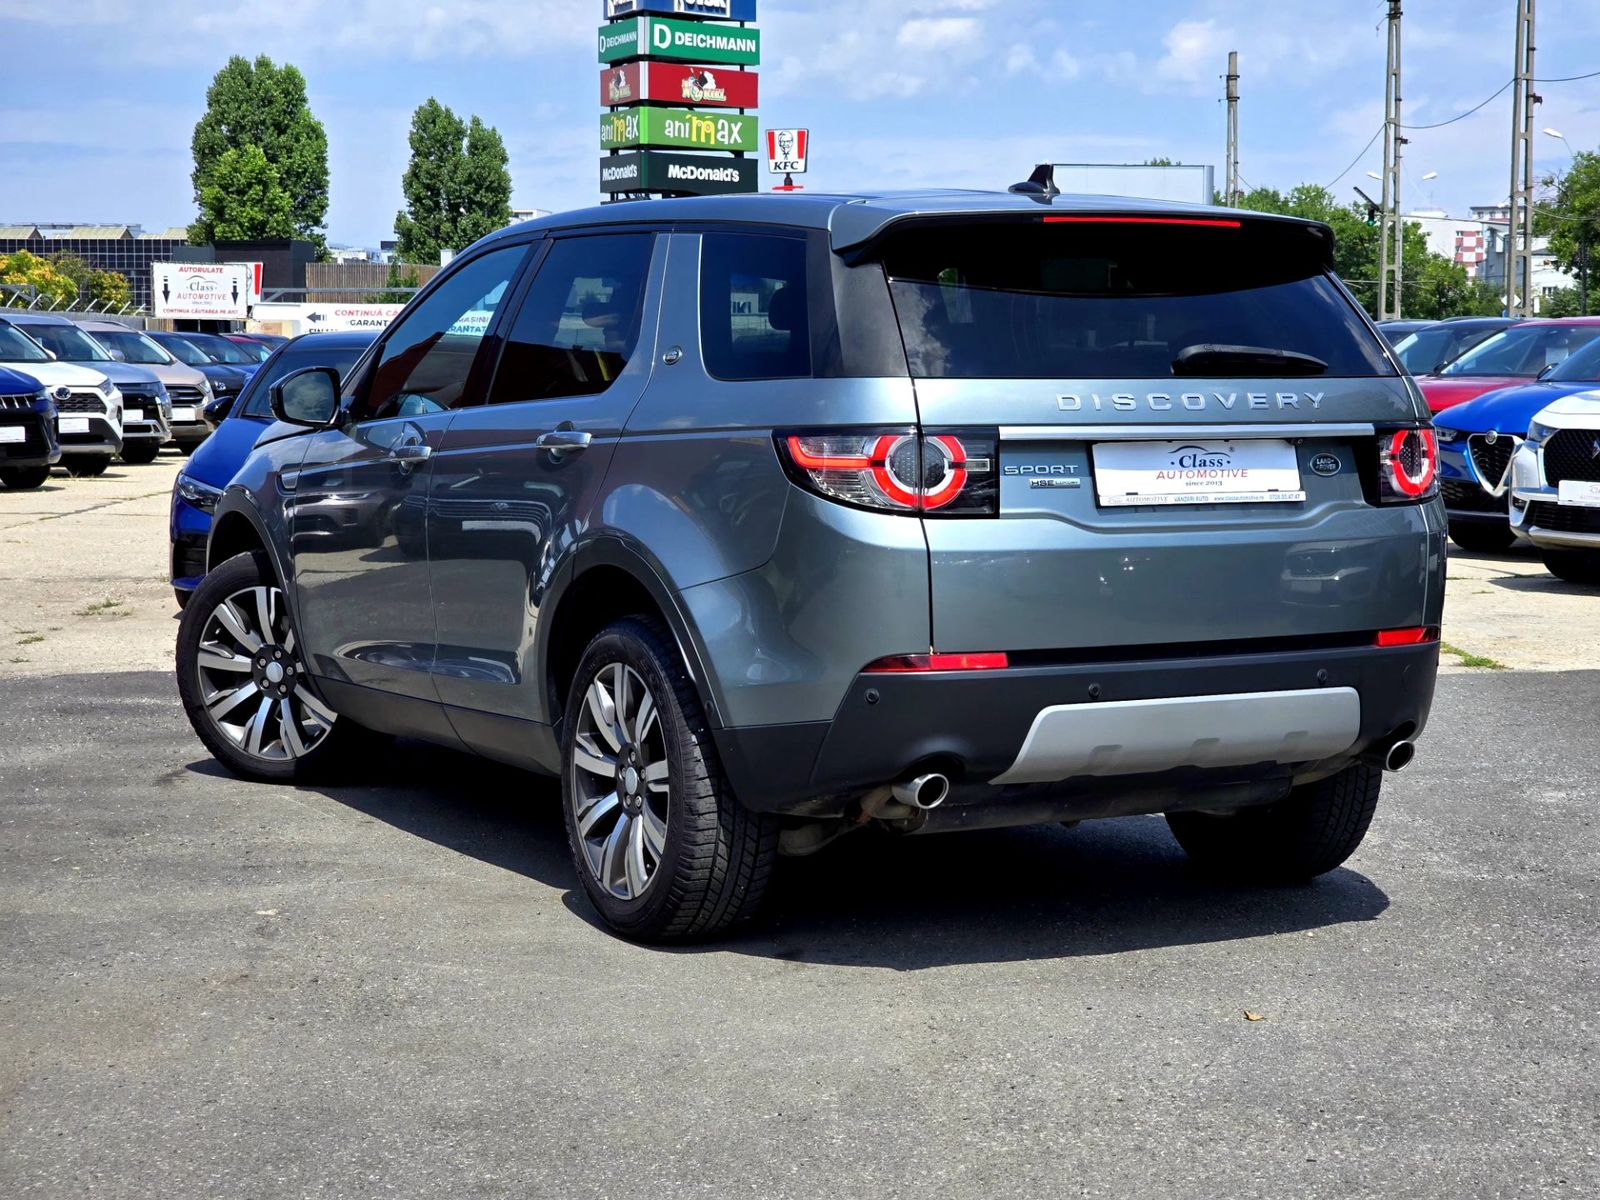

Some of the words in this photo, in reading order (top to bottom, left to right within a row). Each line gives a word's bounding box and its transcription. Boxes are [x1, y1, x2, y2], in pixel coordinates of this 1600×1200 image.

[606, 30, 637, 48] DEICHMANN
[675, 32, 756, 52] DEICHMANN
[665, 114, 742, 145] animax
[773, 160, 799, 171] KFC
[602, 164, 637, 181] McDonald's
[668, 165, 740, 182] McDonald's
[178, 266, 224, 274] AUTORULATE
[189, 281, 214, 291] Class
[177, 292, 227, 300] AUTOMOTIVE
[350, 319, 391, 327] GARANT
[1056, 392, 1326, 411] DISCOVERY
[1179, 454, 1224, 468] Class
[1004, 465, 1078, 475] SPORT
[1156, 469, 1248, 480] AUTOMOTIVE
